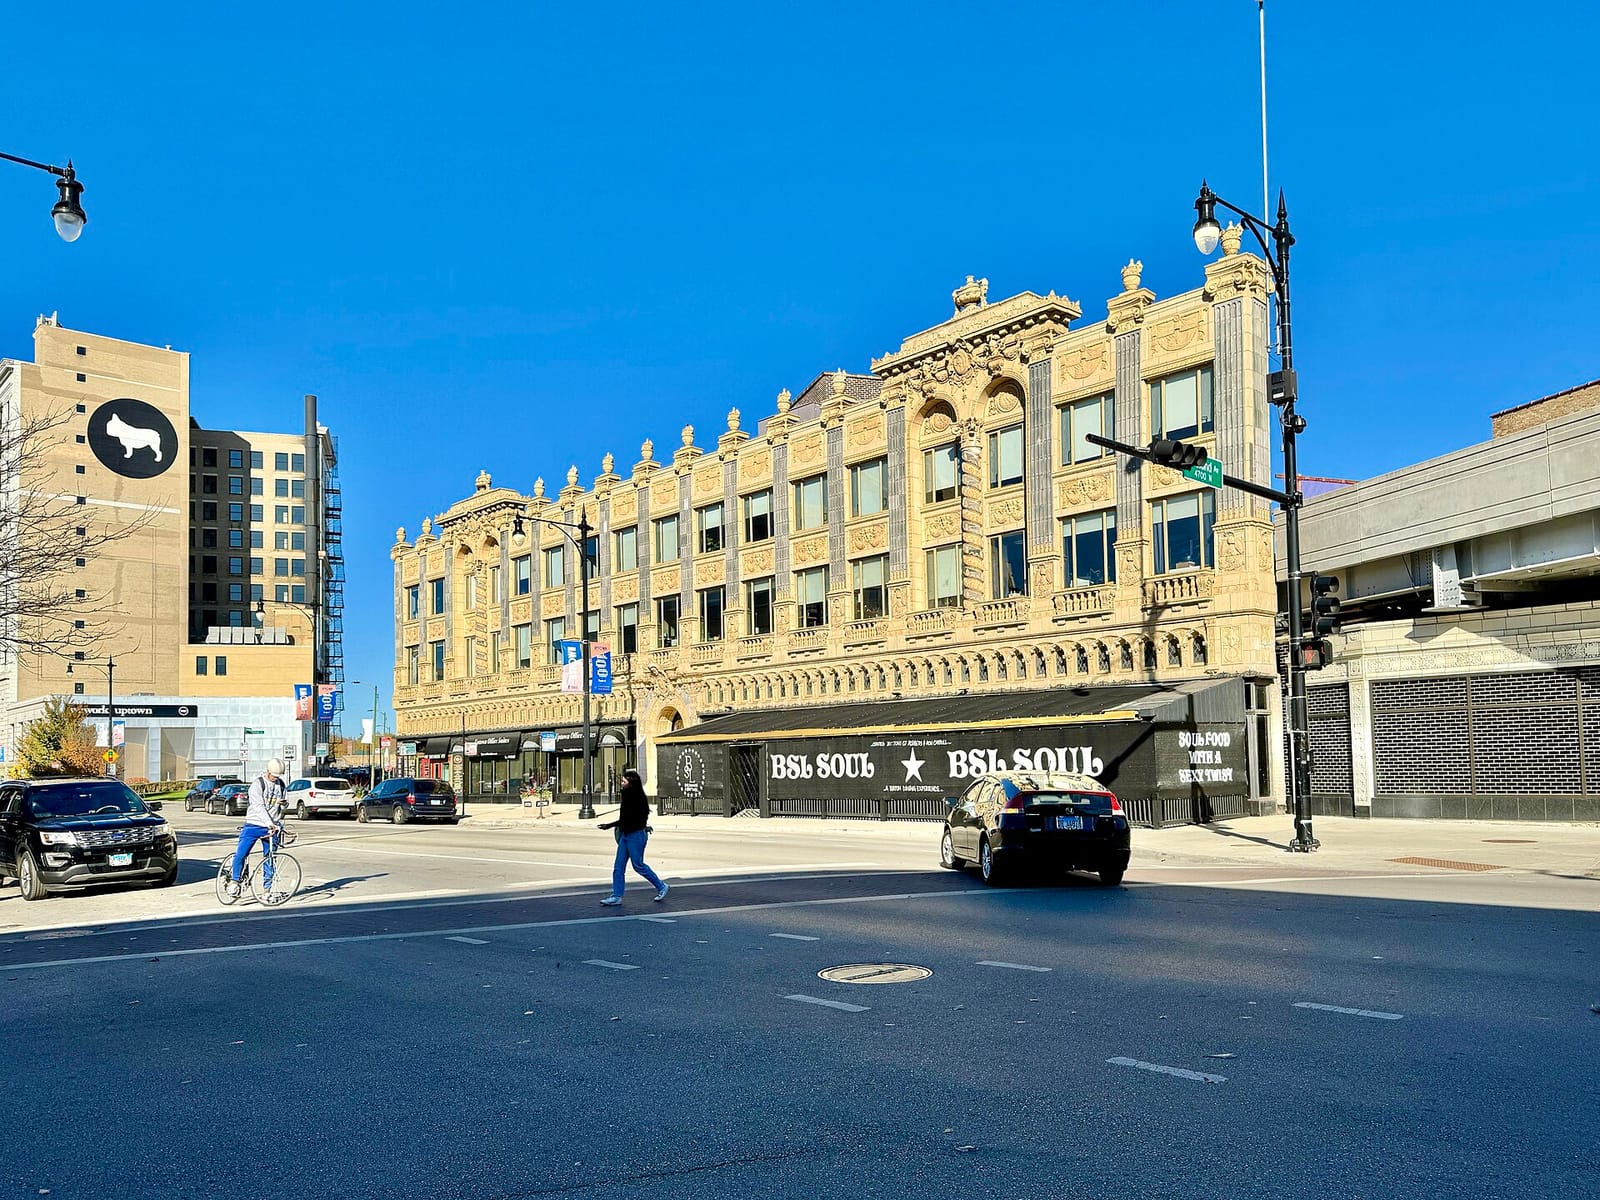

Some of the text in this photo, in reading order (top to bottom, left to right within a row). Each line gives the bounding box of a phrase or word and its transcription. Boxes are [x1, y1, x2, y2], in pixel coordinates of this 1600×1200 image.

[114, 706, 153, 717] uptown
[1178, 731, 1231, 748] SOUL FOOD
[946, 747, 1104, 779] BSL SOUL
[1188, 750, 1223, 764] WITH A
[770, 752, 875, 780] BSL SOUL
[1178, 767, 1234, 783] SEXY TWIST
